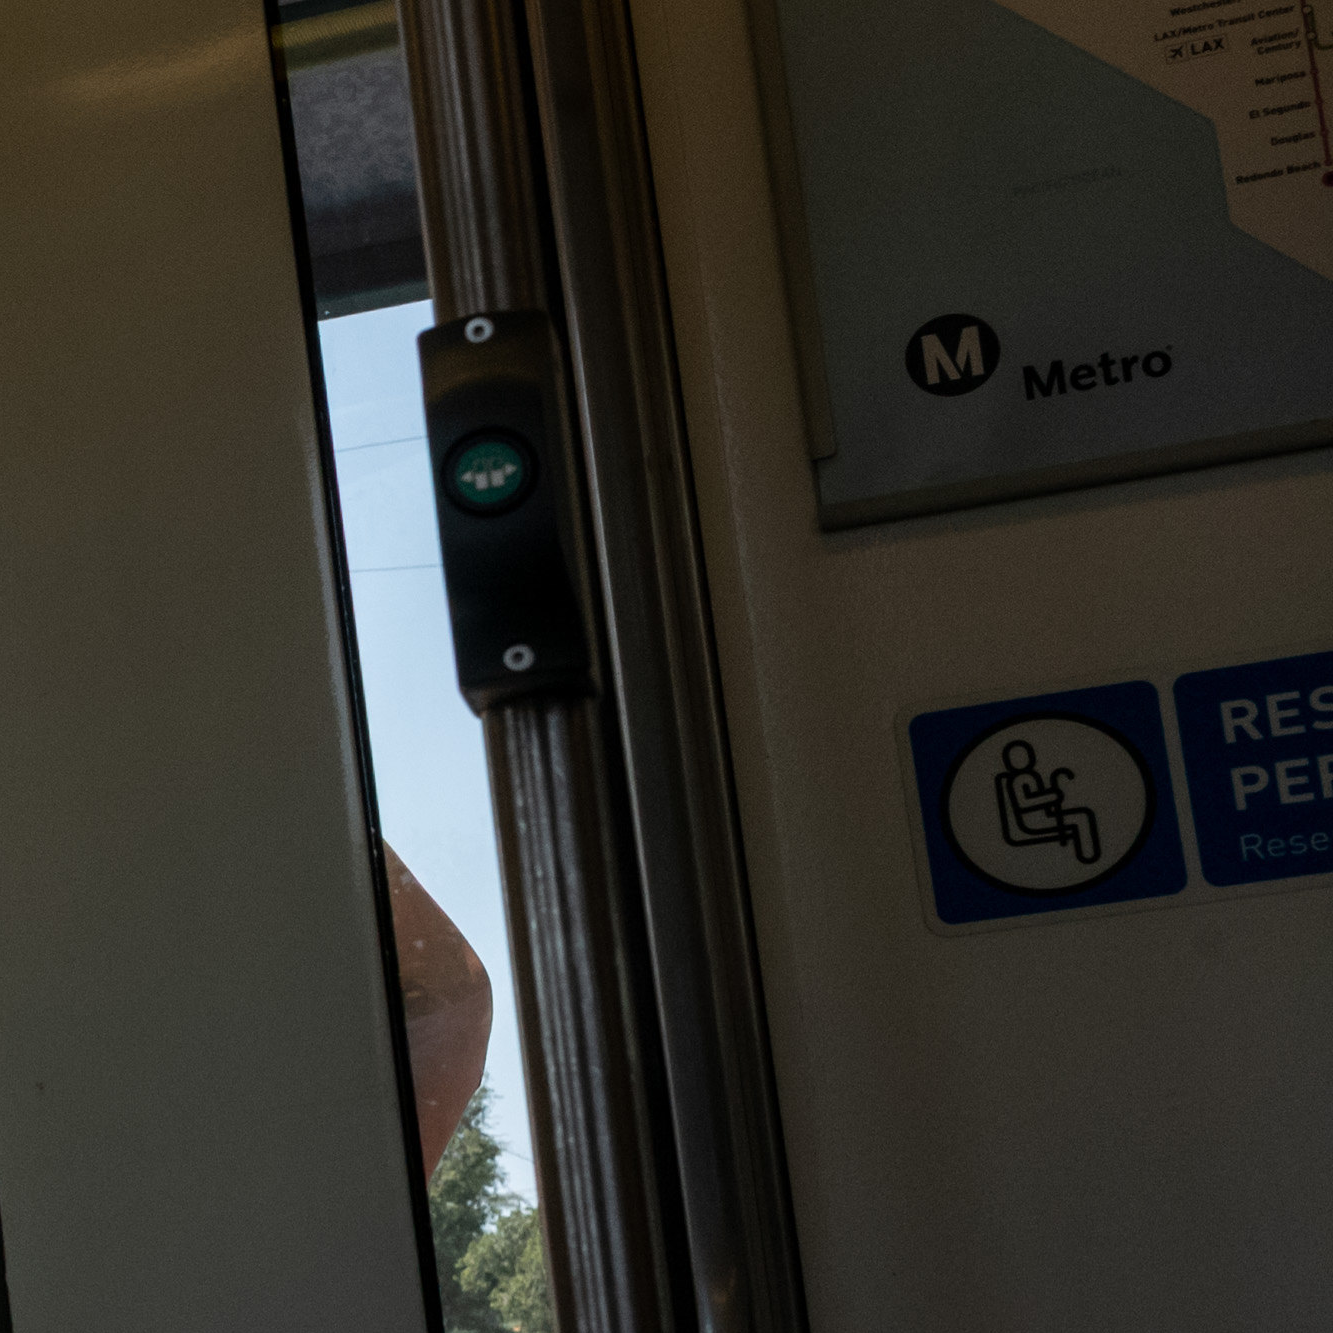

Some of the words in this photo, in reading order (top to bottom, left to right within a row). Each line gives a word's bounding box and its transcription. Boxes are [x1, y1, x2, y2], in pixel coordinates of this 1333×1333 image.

[1154, 24, 1214, 41] LAX/Metro
[1218, 14, 1254, 27] Transit
[1258, 5, 1295, 19] Center
[1191, 38, 1225, 55] LAX
[1257, 41, 1301, 55] Century
[1255, 71, 1306, 86] Mariposa
[1249, 110, 1260, 119] El
[1263, 101, 1311, 116] Segundo
[1270, 131, 1315, 146] Douglas
[1236, 169, 1283, 184] Redondo
[1287, 161, 1321, 174] Beach
[921, 324, 986, 386] M
[1023, 351, 1173, 400] Metro
[1220, 685, 1333, 744] RES
[1240, 831, 1329, 861] Rese
